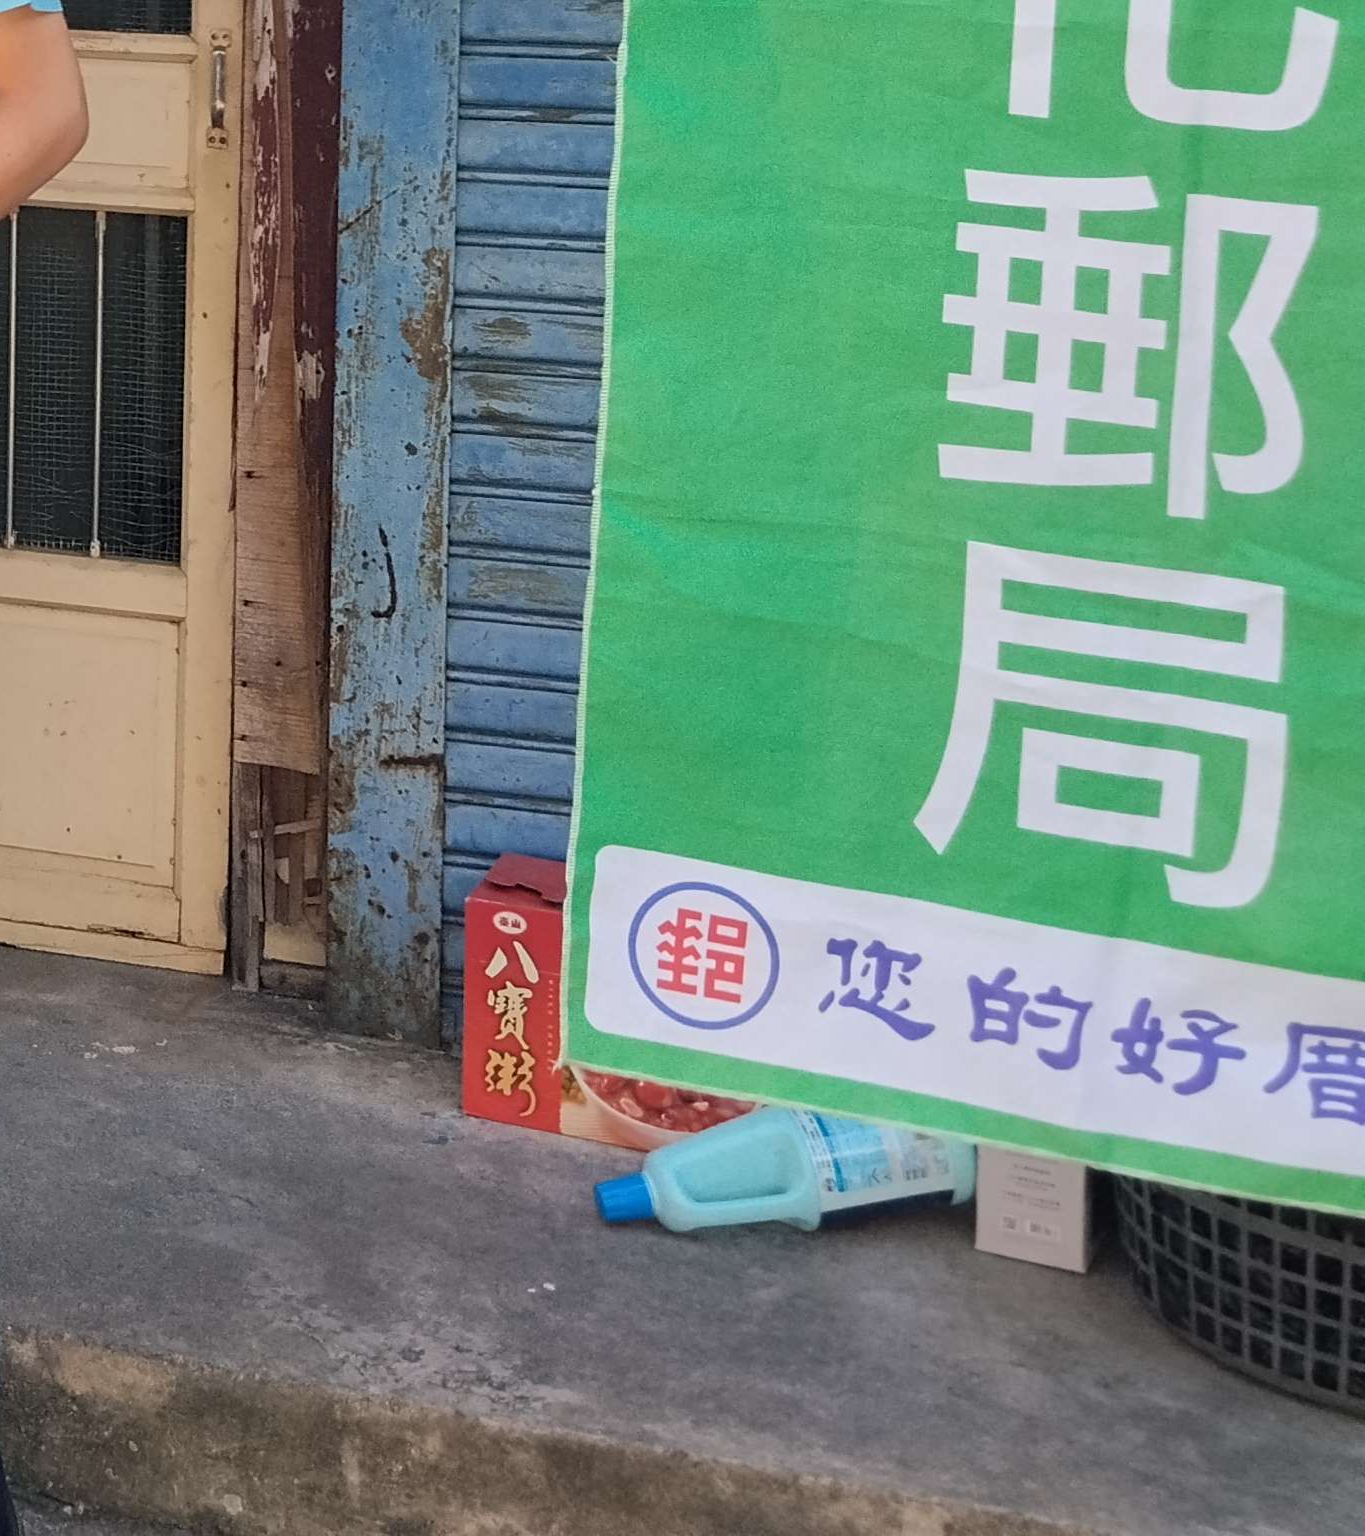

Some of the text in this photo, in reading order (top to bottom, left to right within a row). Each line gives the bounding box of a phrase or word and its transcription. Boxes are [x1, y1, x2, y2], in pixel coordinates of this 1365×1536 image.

[655, 907, 750, 1005] 郵
[484, 940, 540, 1117] 八寶粥
